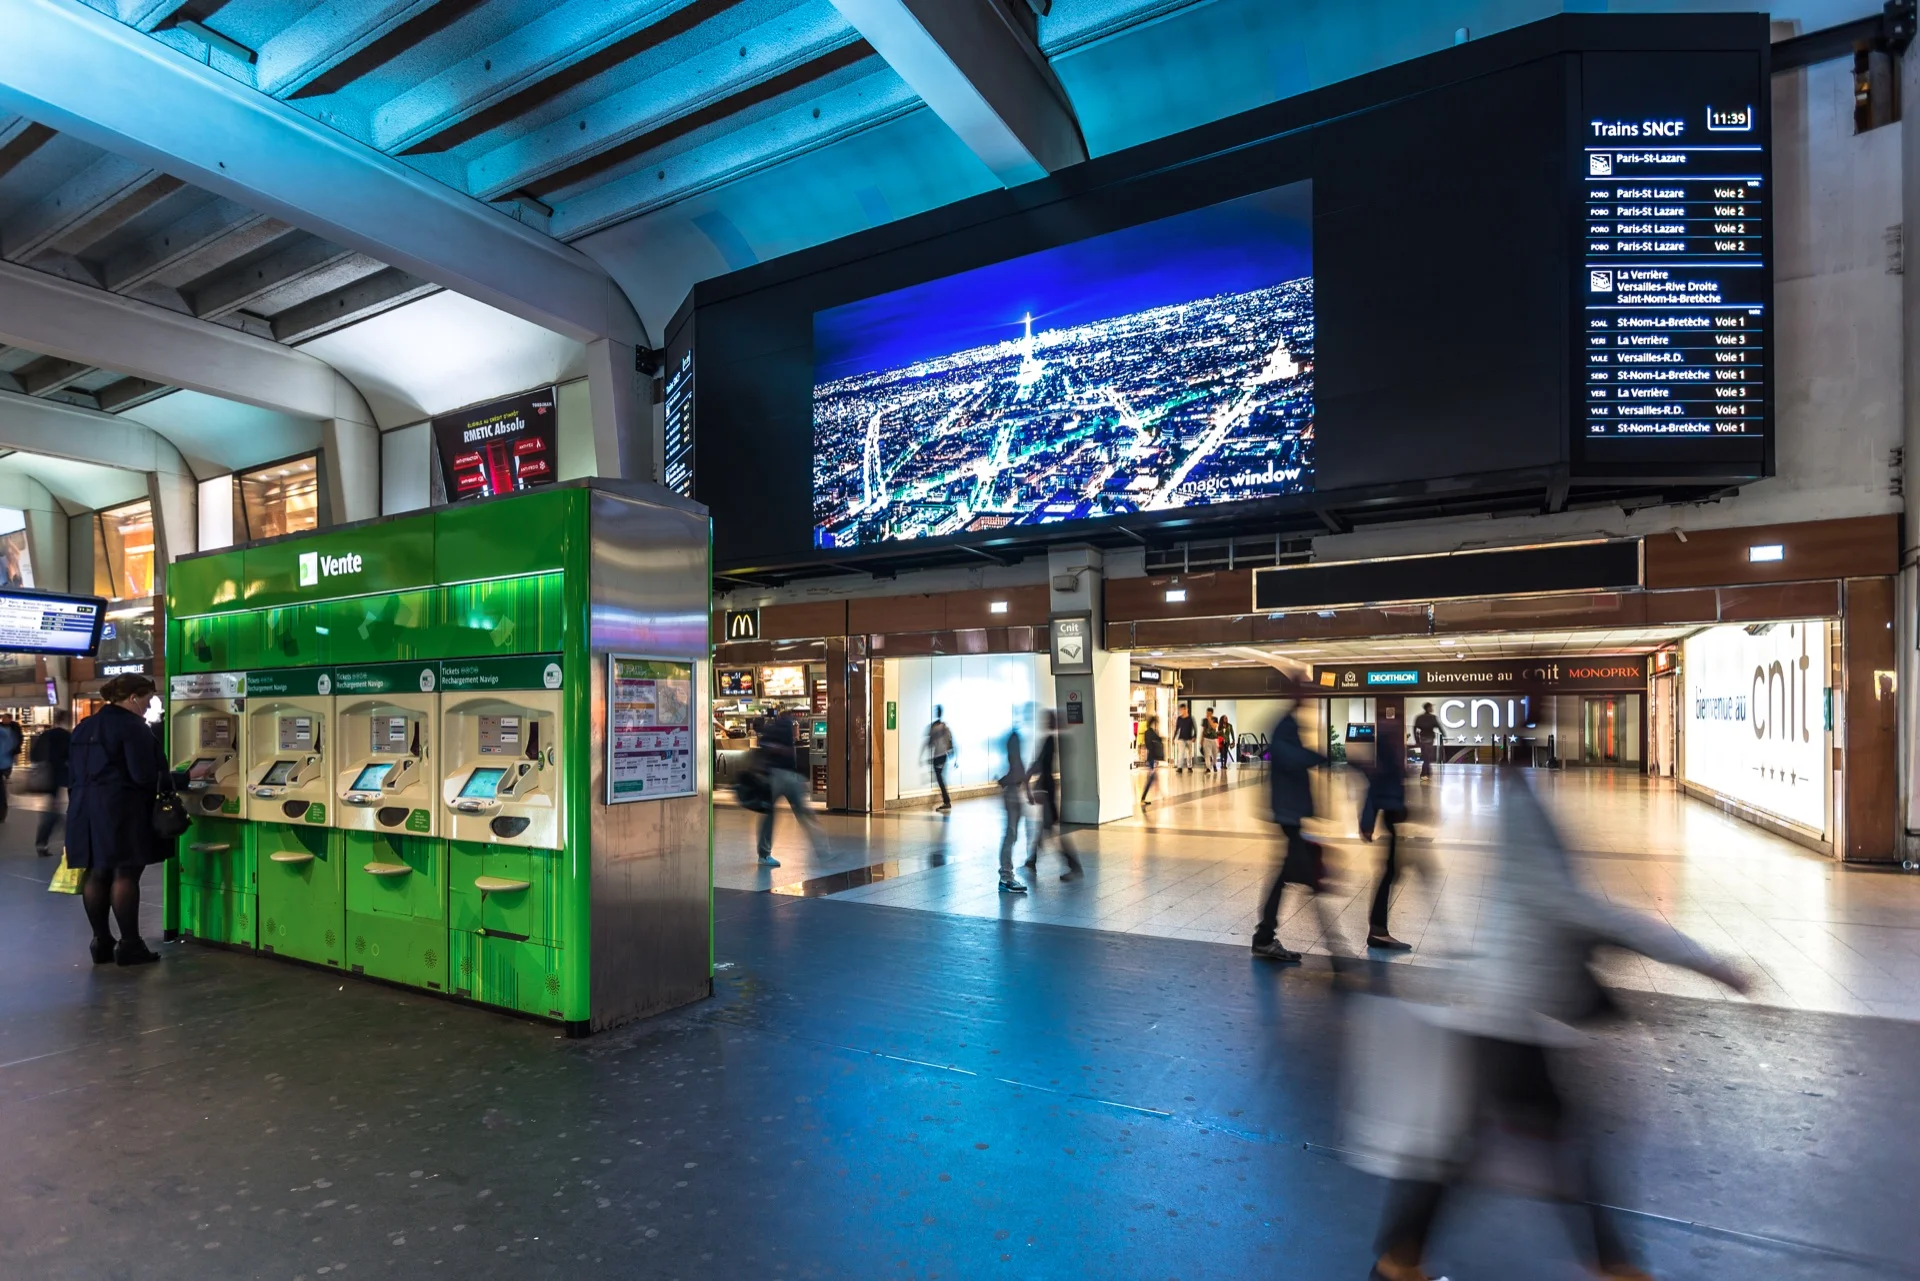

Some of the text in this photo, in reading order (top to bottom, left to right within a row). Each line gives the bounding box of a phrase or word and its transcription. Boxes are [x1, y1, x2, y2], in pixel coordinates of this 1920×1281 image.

[1712, 113, 1746, 125] 11:39
[1591, 121, 1684, 136] Trains SNCF
[1617, 188, 1652, 198] Paris-St
[1654, 188, 1684, 198] Lazare
[1714, 188, 1736, 198] Voie
[1738, 188, 1744, 198] 2
[1617, 206, 1652, 216] Paris-St
[1654, 206, 1684, 216] Lazare
[1714, 206, 1736, 216] Voie
[1738, 206, 1744, 216] 2
[1617, 224, 1652, 234] Paris-St
[1654, 224, 1684, 234] Lazare
[1714, 224, 1736, 233] Voie
[1738, 224, 1744, 233] 2
[1617, 242, 1652, 251] Paris-St
[1654, 242, 1684, 251] Lazare
[1714, 241, 1736, 250] Voie
[1738, 241, 1744, 250] 2
[1618, 270, 1668, 280] La Verrière
[1688, 282, 1718, 292] Droite
[1716, 317, 1737, 326] Voie
[1740, 317, 1745, 326] 1
[1618, 336, 1628, 344] La
[1631, 335, 1668, 344] Verrière
[1716, 334, 1737, 344] Voie
[1740, 334, 1745, 344] 3
[1716, 352, 1737, 362] Voie
[1740, 352, 1745, 362] 1
[1716, 370, 1737, 379] Voie
[1740, 370, 1745, 379] 1
[1618, 388, 1628, 397] La
[1631, 388, 1668, 397] Verrière
[1716, 387, 1737, 396] Voie
[1740, 387, 1745, 396] 3
[1716, 404, 1737, 414] Voie
[1740, 404, 1745, 414] 1
[464, 417, 525, 442] RMETIC Absolu
[1716, 422, 1737, 432] Voie
[1740, 422, 1745, 432] 1
[320, 552, 362, 577] Vente
[1060, 624, 1078, 632] Cnit
[1427, 672, 1493, 682] bienvenue
[1498, 672, 1512, 681] au
[1569, 667, 1639, 678] MONOPRIX
[442, 676, 498, 685] Rechargement Navigo
[1370, 674, 1415, 682] DECATHLON
[1752, 621, 1809, 743] cnit
[336, 680, 384, 689] Rechargement Navigo
[1696, 686, 1746, 721] bienvenue au
